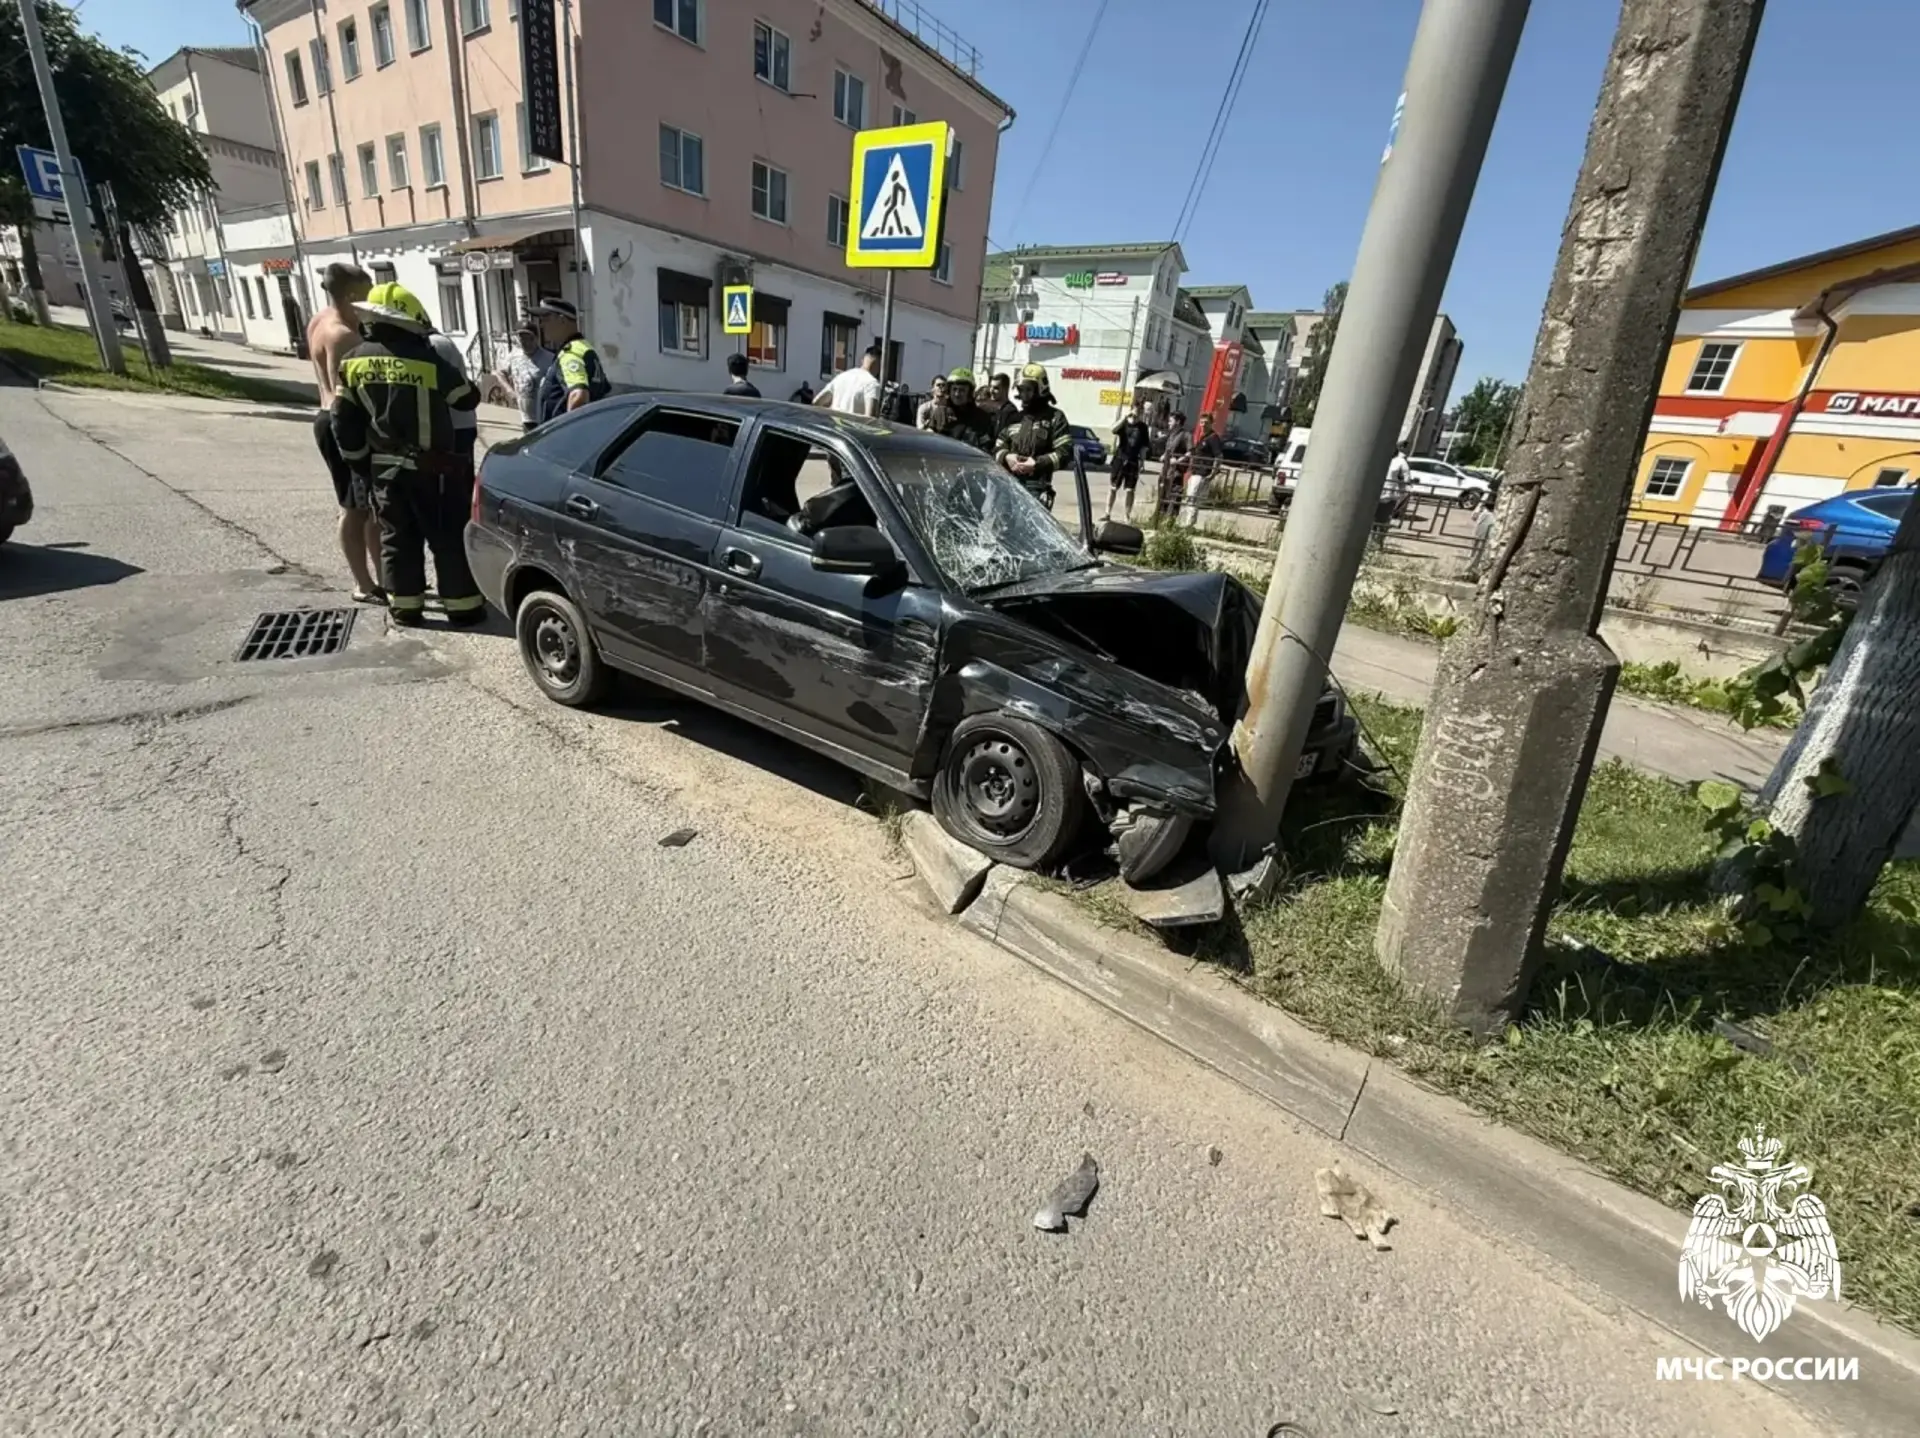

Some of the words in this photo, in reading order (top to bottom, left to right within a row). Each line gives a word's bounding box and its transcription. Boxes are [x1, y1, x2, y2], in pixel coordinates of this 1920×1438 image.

[393, 299, 407, 312] 12
[367, 358, 405, 370] МЧС
[355, 371, 423, 385] РОССИИ
